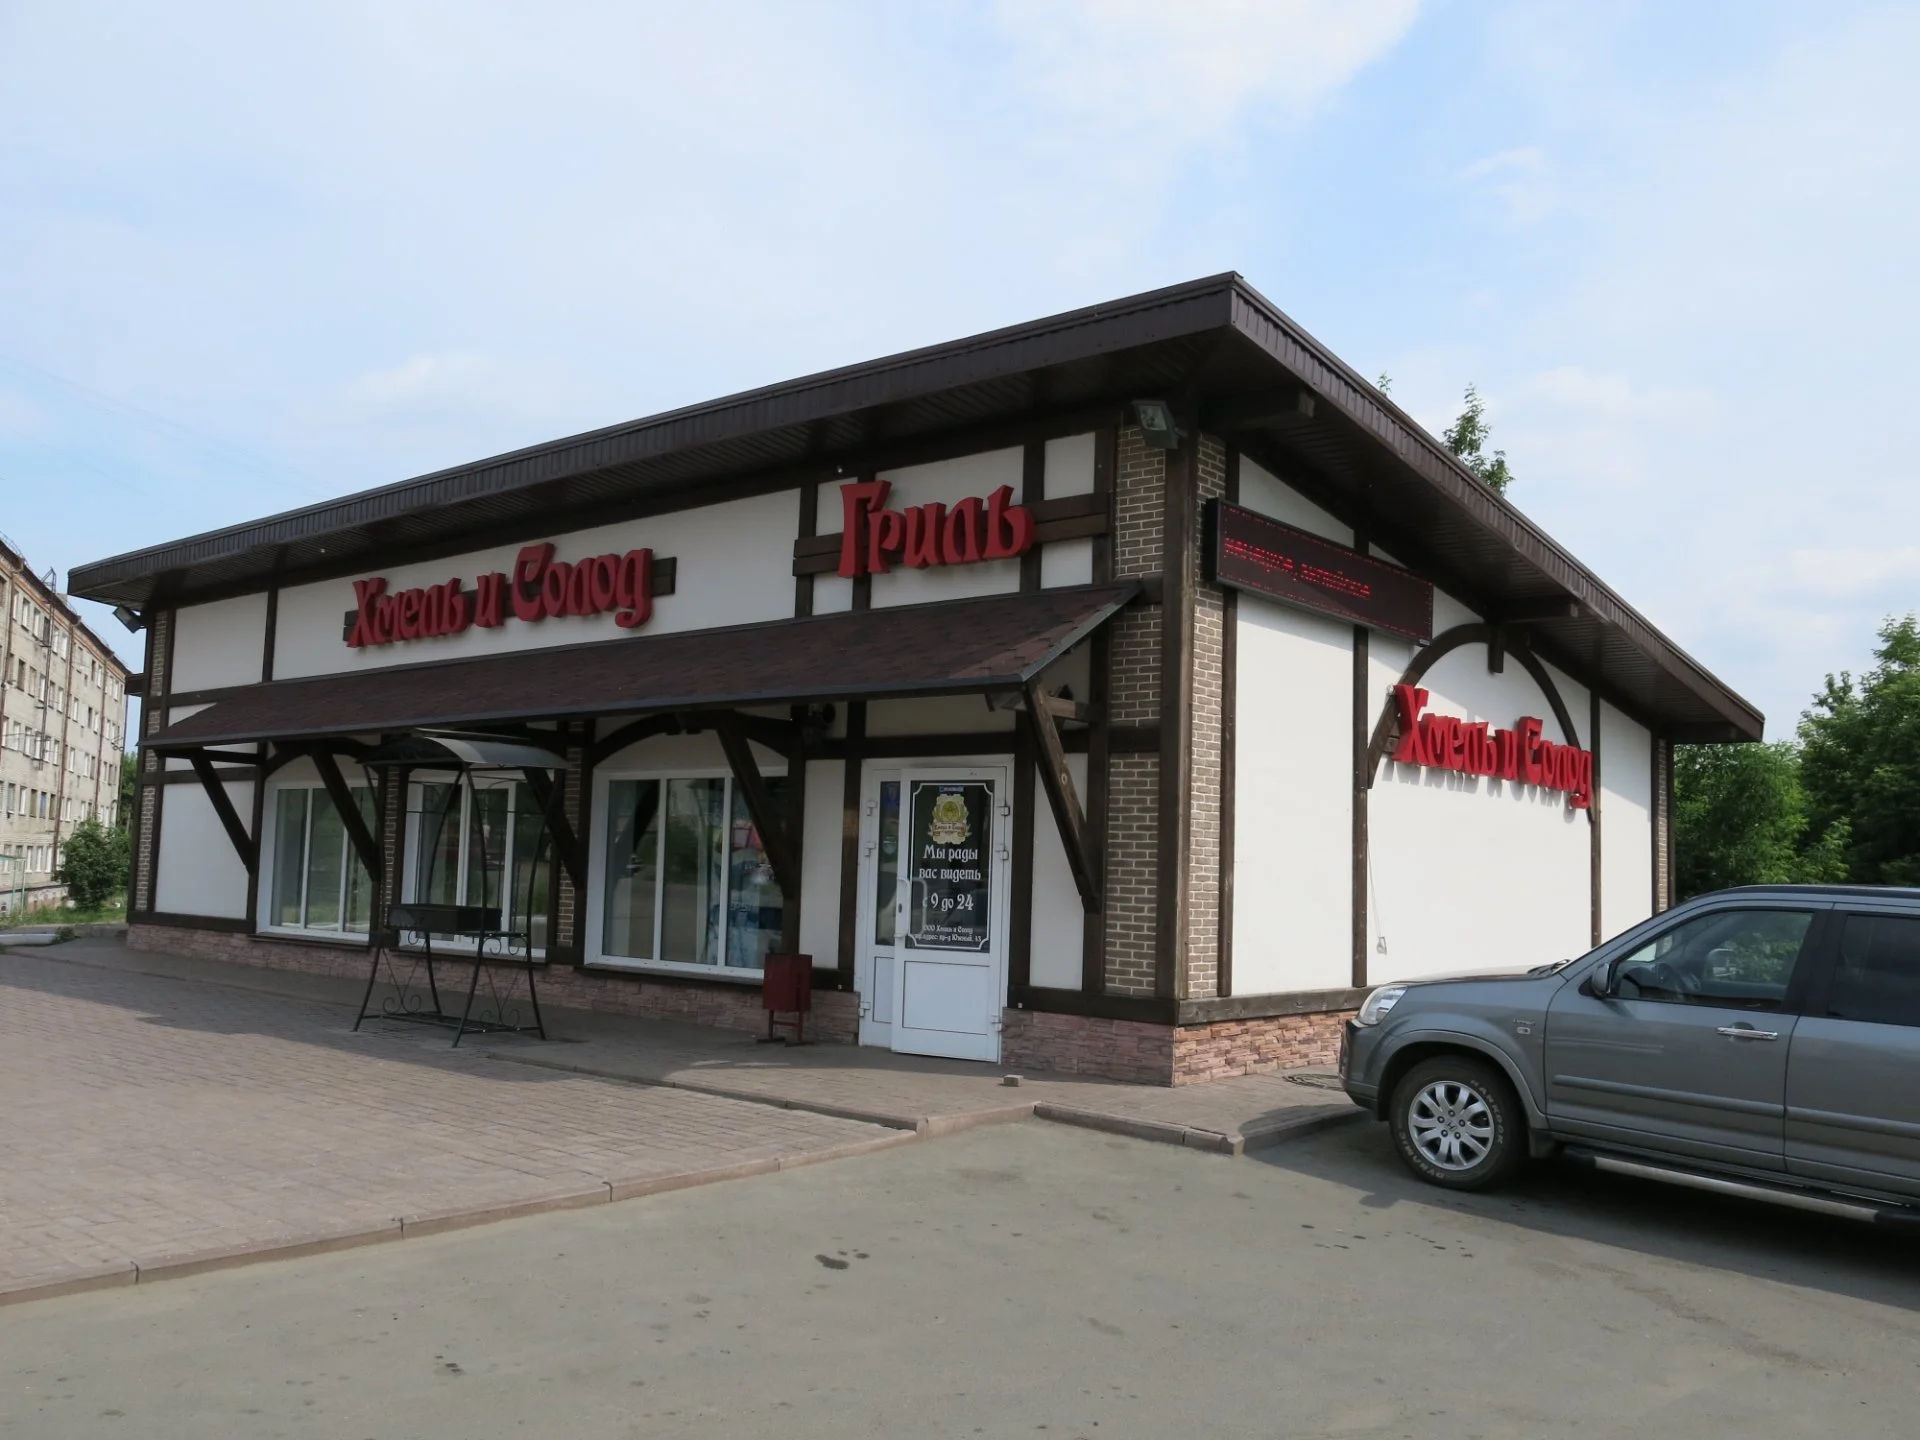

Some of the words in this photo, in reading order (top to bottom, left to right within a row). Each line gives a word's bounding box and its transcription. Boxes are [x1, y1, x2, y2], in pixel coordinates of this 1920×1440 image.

[837, 480, 1036, 579] Гриль
[347, 577, 470, 648] Хмель
[475, 572, 507, 628] и
[512, 542, 654, 629] Солод
[1393, 684, 1497, 777] Хмель
[1495, 729, 1519, 780] и
[1517, 716, 1592, 809] Солод
[919, 868, 938, 879] вас
[940, 868, 981, 882] видеть
[923, 844, 945, 859] Мы
[948, 848, 978, 862] рады
[930, 892, 939, 909] 9
[941, 898, 954, 912] до
[956, 894, 974, 911] 24
